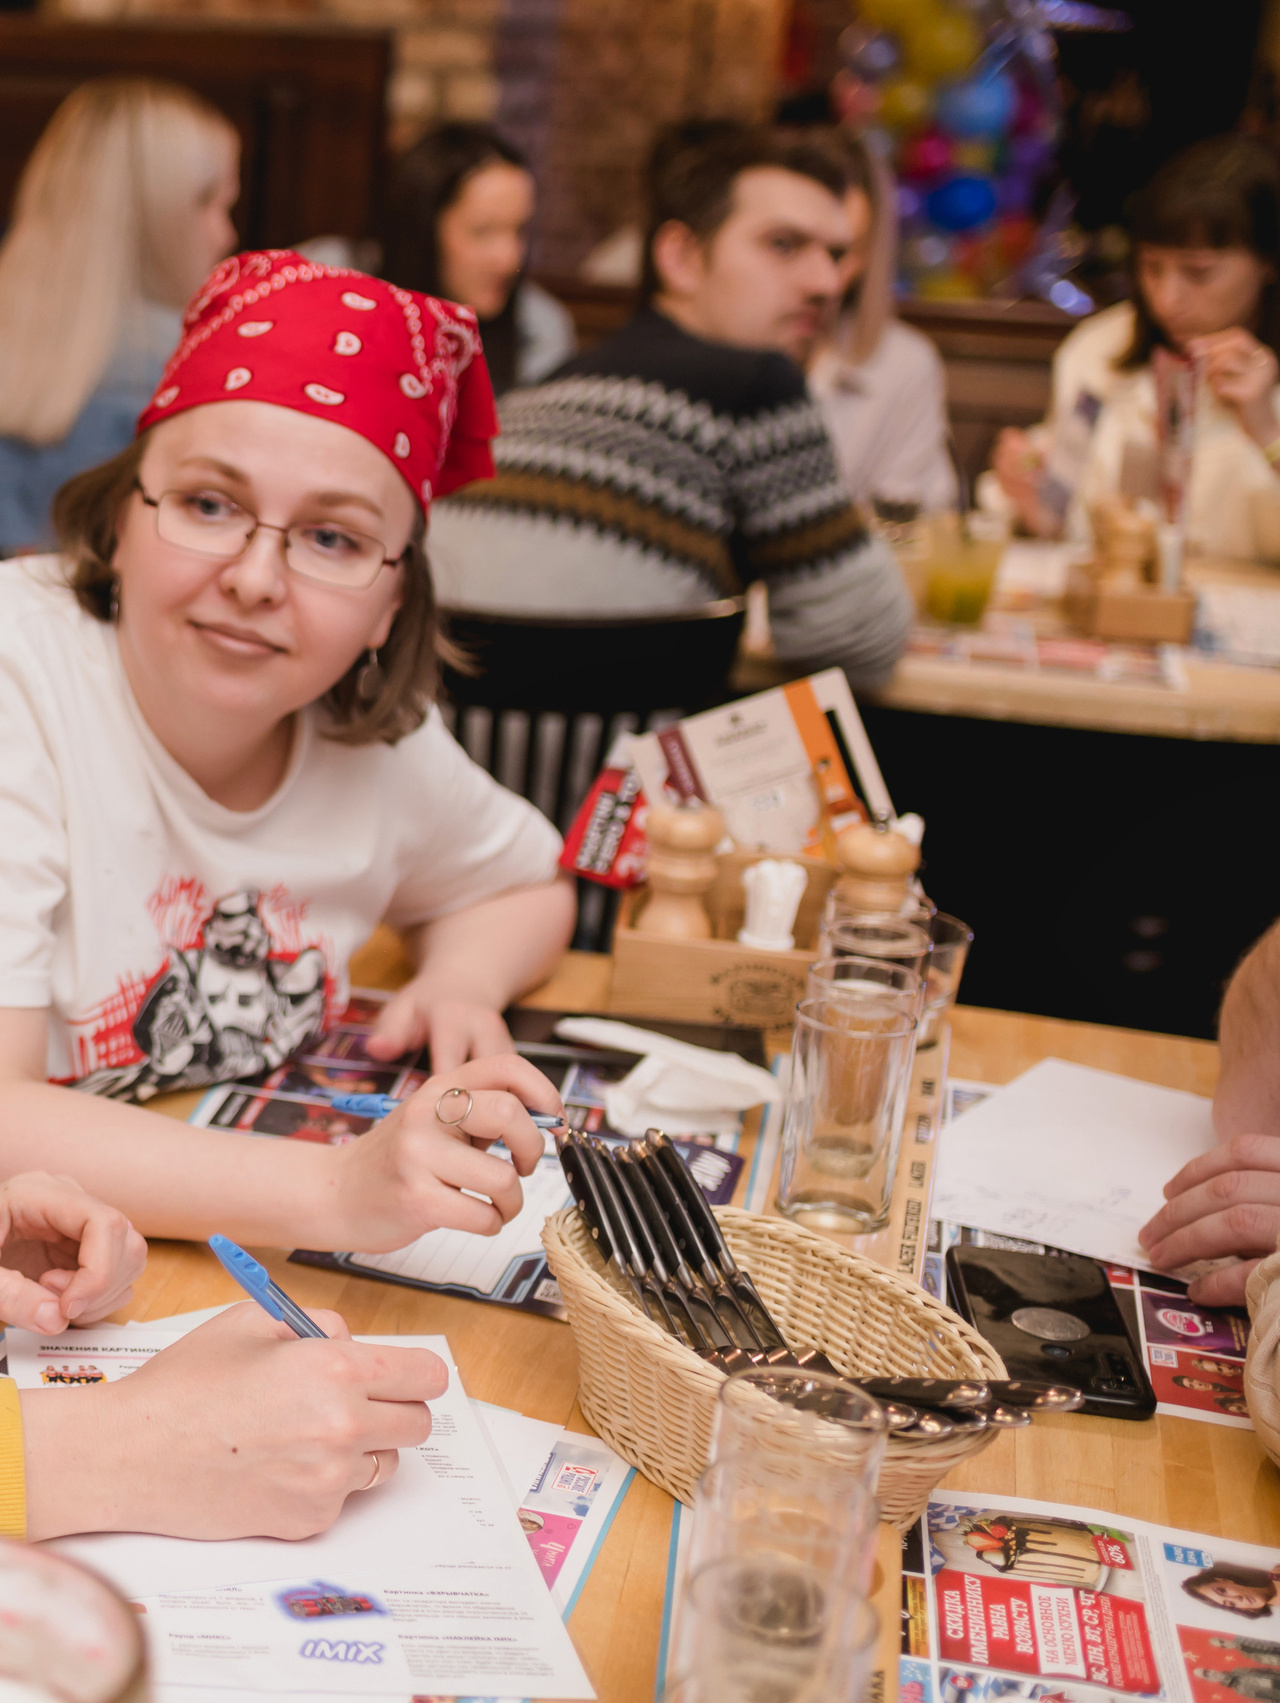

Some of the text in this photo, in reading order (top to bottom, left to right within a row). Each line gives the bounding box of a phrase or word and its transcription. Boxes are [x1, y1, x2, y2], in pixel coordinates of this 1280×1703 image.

[541, 1549, 560, 1567] МАРТА
[1107, 1544, 1125, 1564] 60%
[383, 1589, 424, 1597] Картинка
[944, 1591, 965, 1639] СКИДКА
[964, 1574, 989, 1665] ИМЕНИННИКУ
[989, 1604, 1009, 1640] РАВНА
[1010, 1597, 1034, 1654] ВОЗРАСТУ
[1038, 1595, 1060, 1665] НА ОСНОВНОЕ
[1056, 1597, 1078, 1666] МЕНЮ КУХНИ
[1079, 1590, 1109, 1684] ВС, ПН, ВТ, СР, ЧТ
[1103, 1617, 1121, 1664] КОНЦЕРТНЫХ
[956, 1676, 969, 1689] 18+
[1111, 1664, 1124, 1687] КРОМЕ
